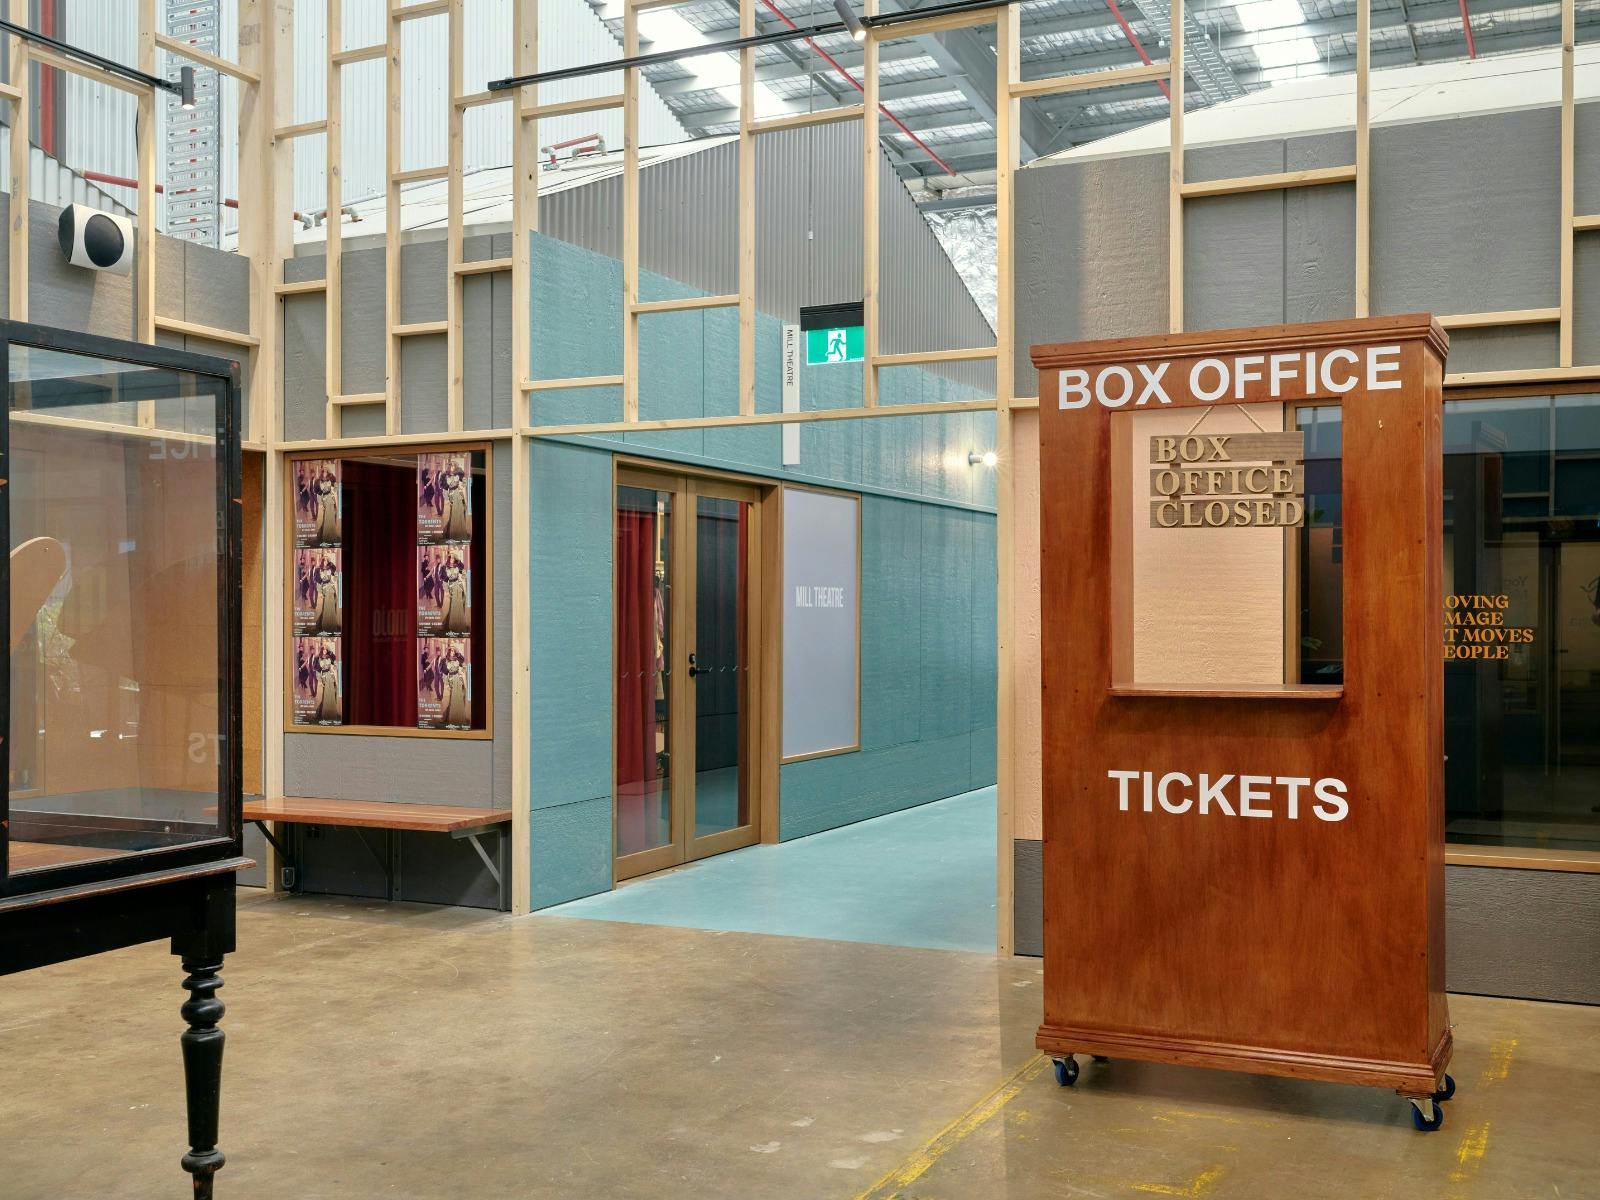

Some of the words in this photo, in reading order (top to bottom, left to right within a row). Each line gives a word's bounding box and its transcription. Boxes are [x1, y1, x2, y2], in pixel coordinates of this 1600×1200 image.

[1058, 362, 1172, 410] BOX
[1189, 345, 1402, 400] OFFICE
[1155, 436, 1232, 462] BOX
[1155, 468, 1294, 496] OFFICE
[1156, 500, 1304, 527] CLOSED
[796, 586, 813, 608] MILL
[813, 586, 844, 608] THEATRE
[1443, 595, 1509, 609] OVING
[1444, 612, 1504, 626] MAGE
[1463, 628, 1535, 643] MOVES
[1443, 645, 1509, 660] EOPLE
[1108, 770, 1349, 822] TICKETS
